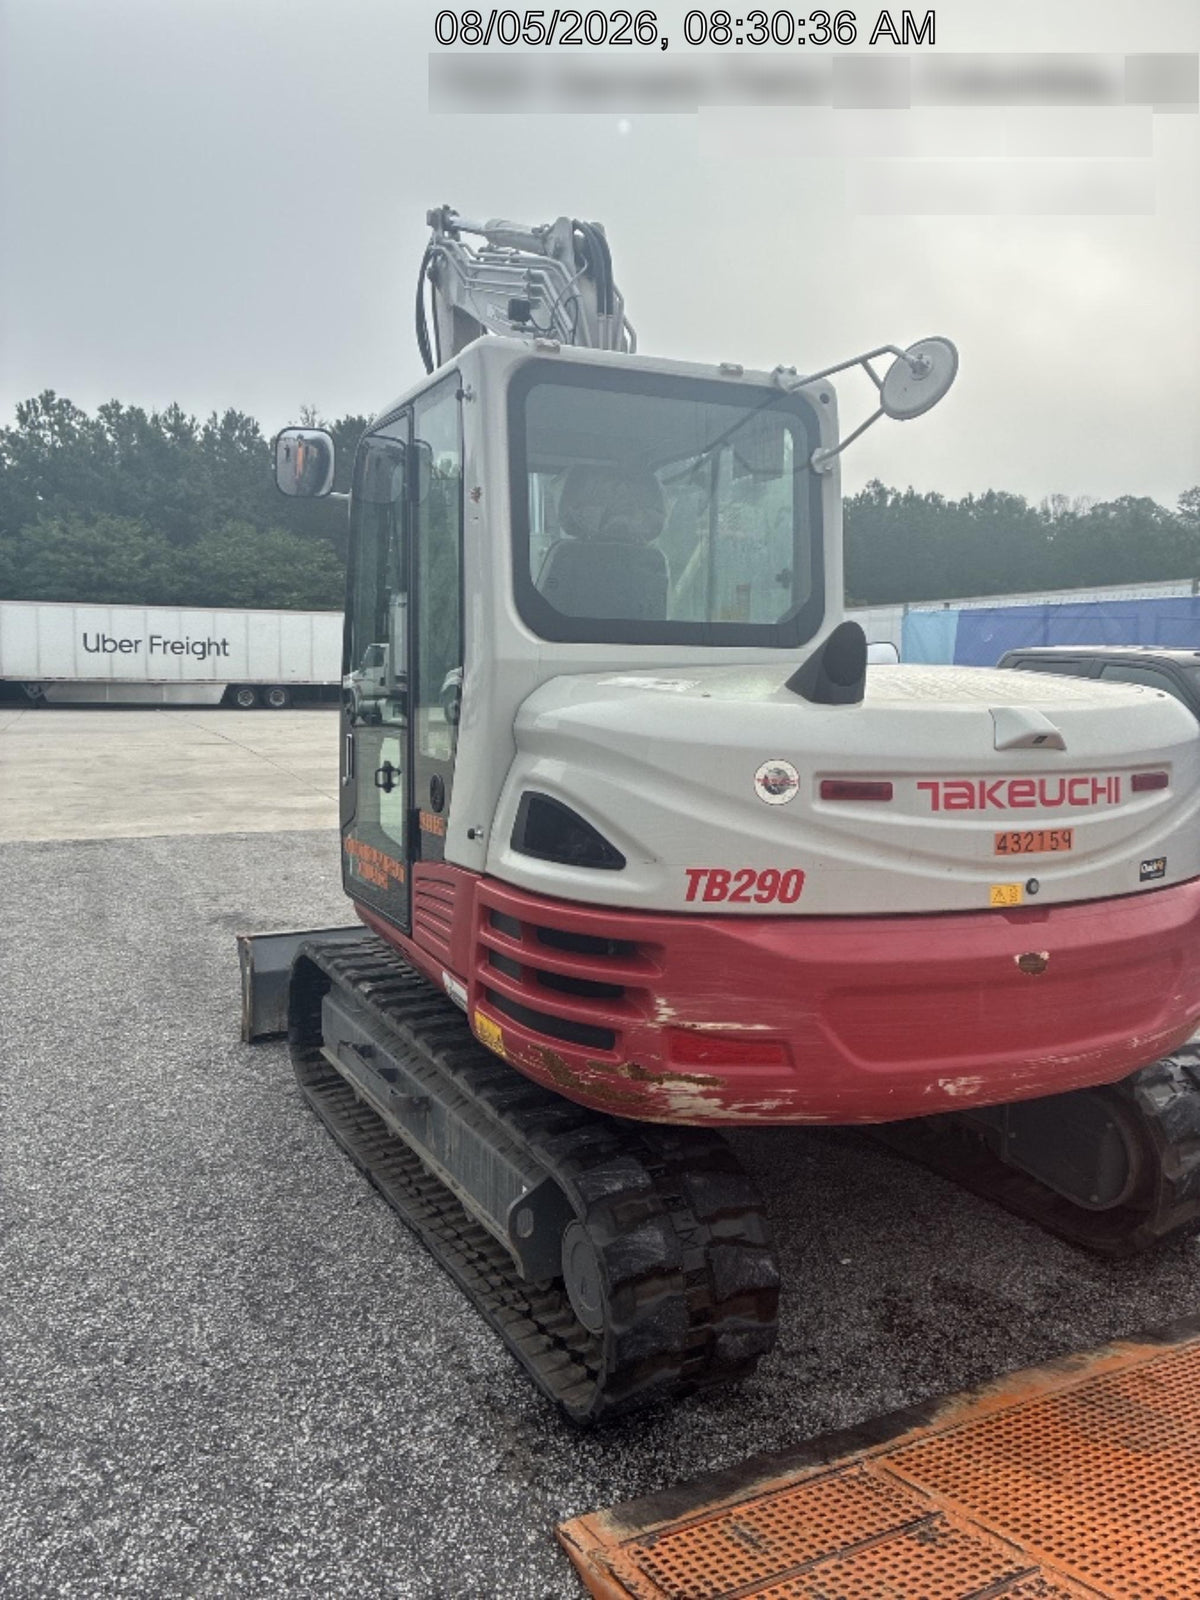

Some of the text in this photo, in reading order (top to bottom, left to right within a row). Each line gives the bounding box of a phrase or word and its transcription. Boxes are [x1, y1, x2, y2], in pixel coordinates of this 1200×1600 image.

[82, 632, 229, 660] Uber Freight
[996, 830, 1073, 854] 432159
[686, 868, 805, 904] TB290
